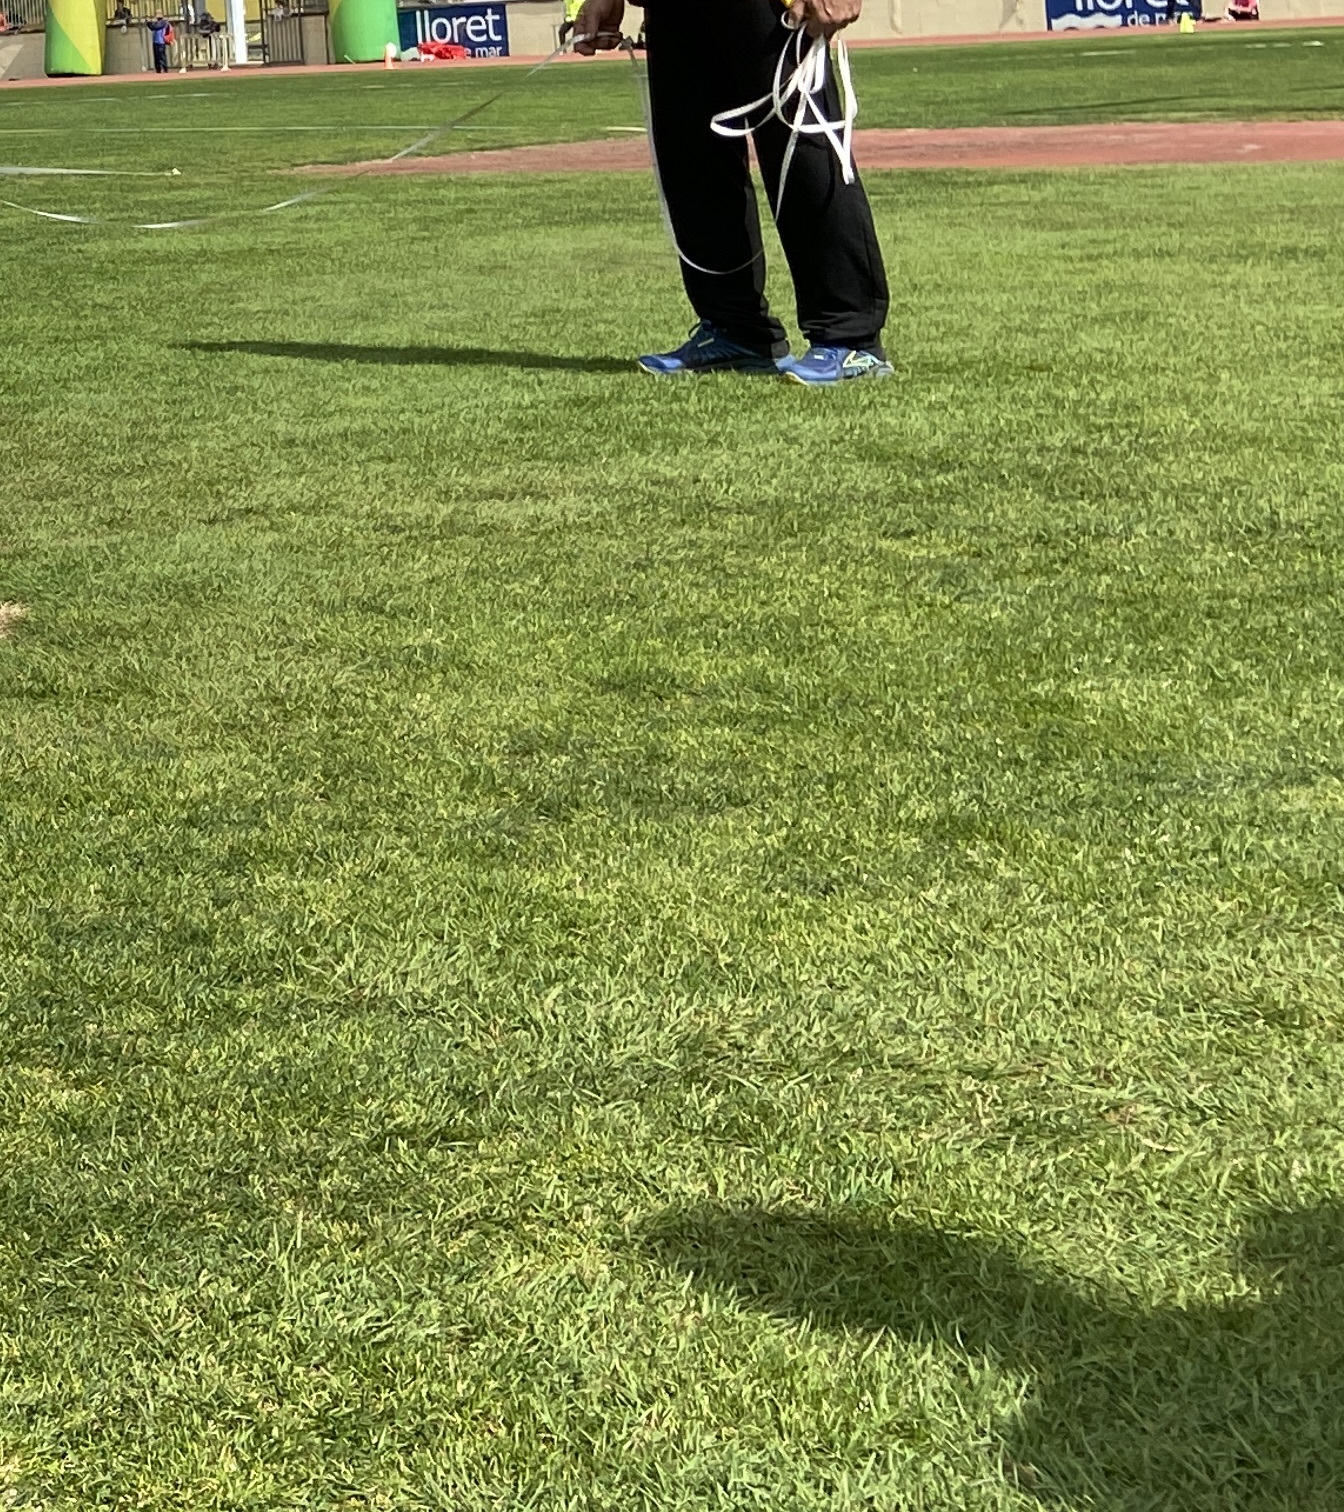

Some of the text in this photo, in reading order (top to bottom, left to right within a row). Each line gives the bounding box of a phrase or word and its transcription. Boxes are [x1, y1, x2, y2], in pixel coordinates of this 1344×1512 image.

[416, 8, 502, 44] lloret
[1127, 10, 1150, 27] de
[475, 46, 502, 59] mar
